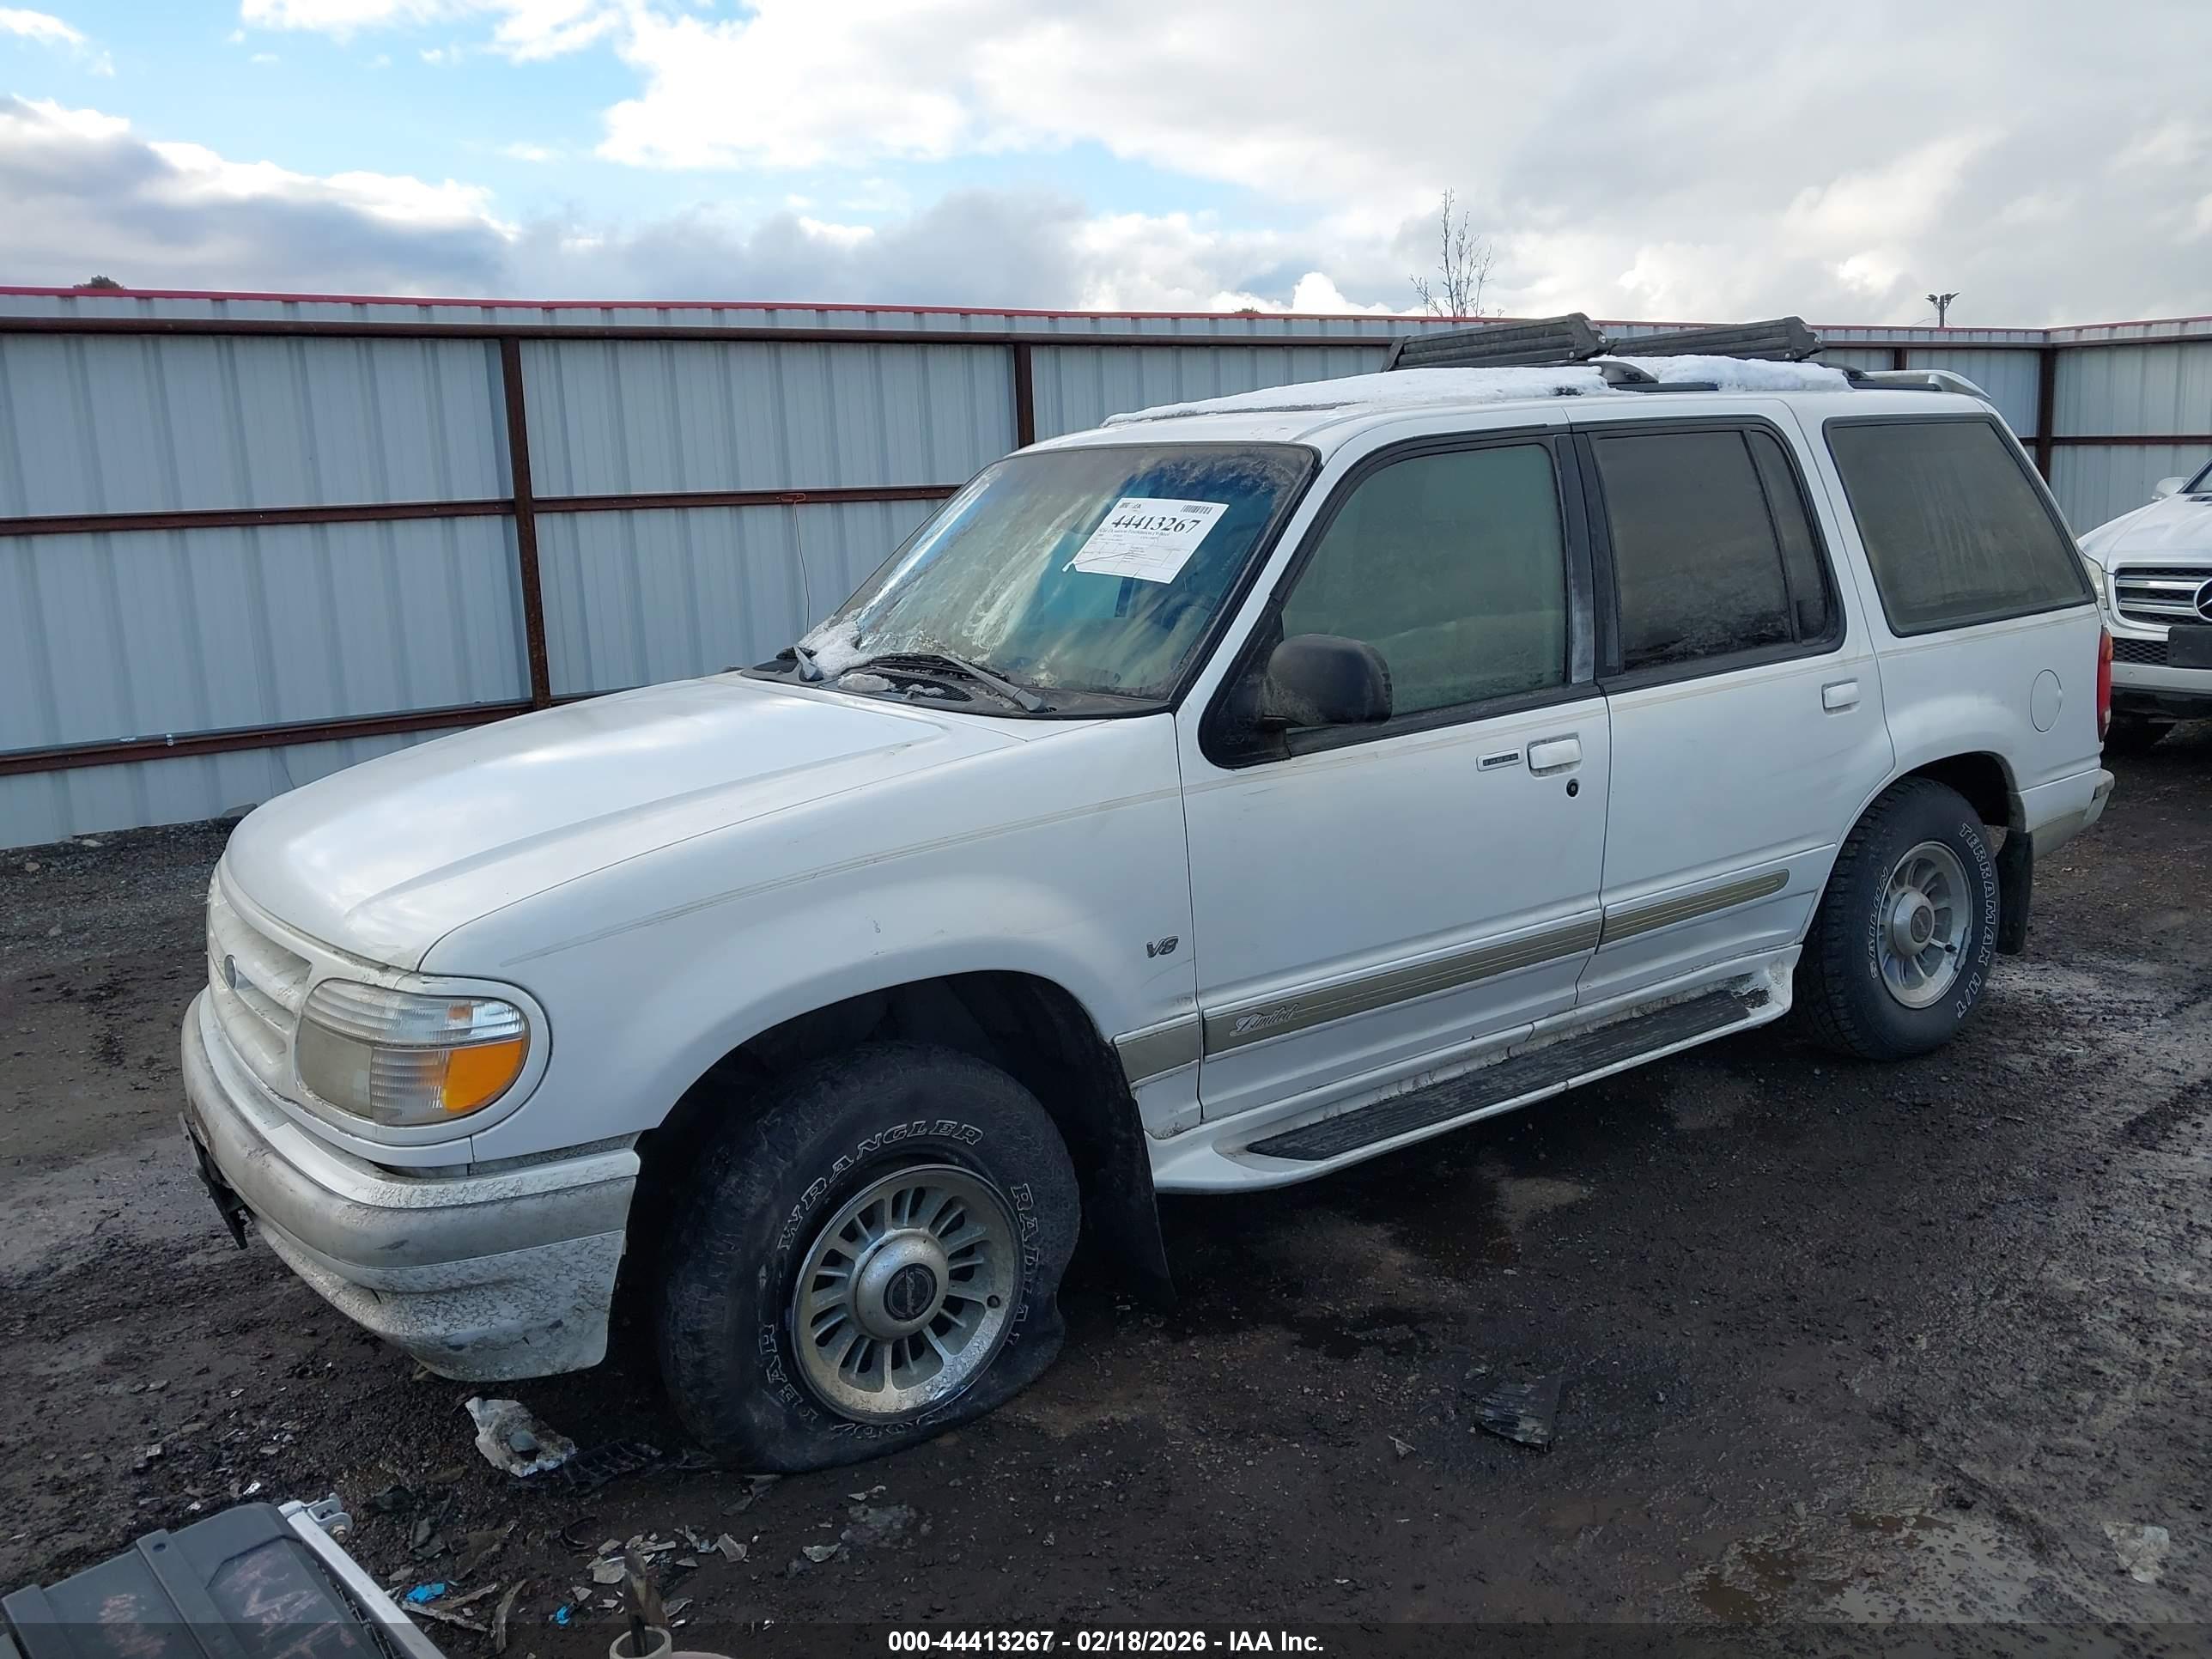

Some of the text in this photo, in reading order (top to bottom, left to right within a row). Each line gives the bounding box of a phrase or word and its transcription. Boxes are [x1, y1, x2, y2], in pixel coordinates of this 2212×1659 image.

[1111, 514, 1202, 534] 44413267
[1958, 823, 1996, 967] TERRAMAX
[1146, 935, 1179, 959] V8
[1229, 1003, 1299, 1037] Limited
[778, 1119, 985, 1253] WRANGLER
